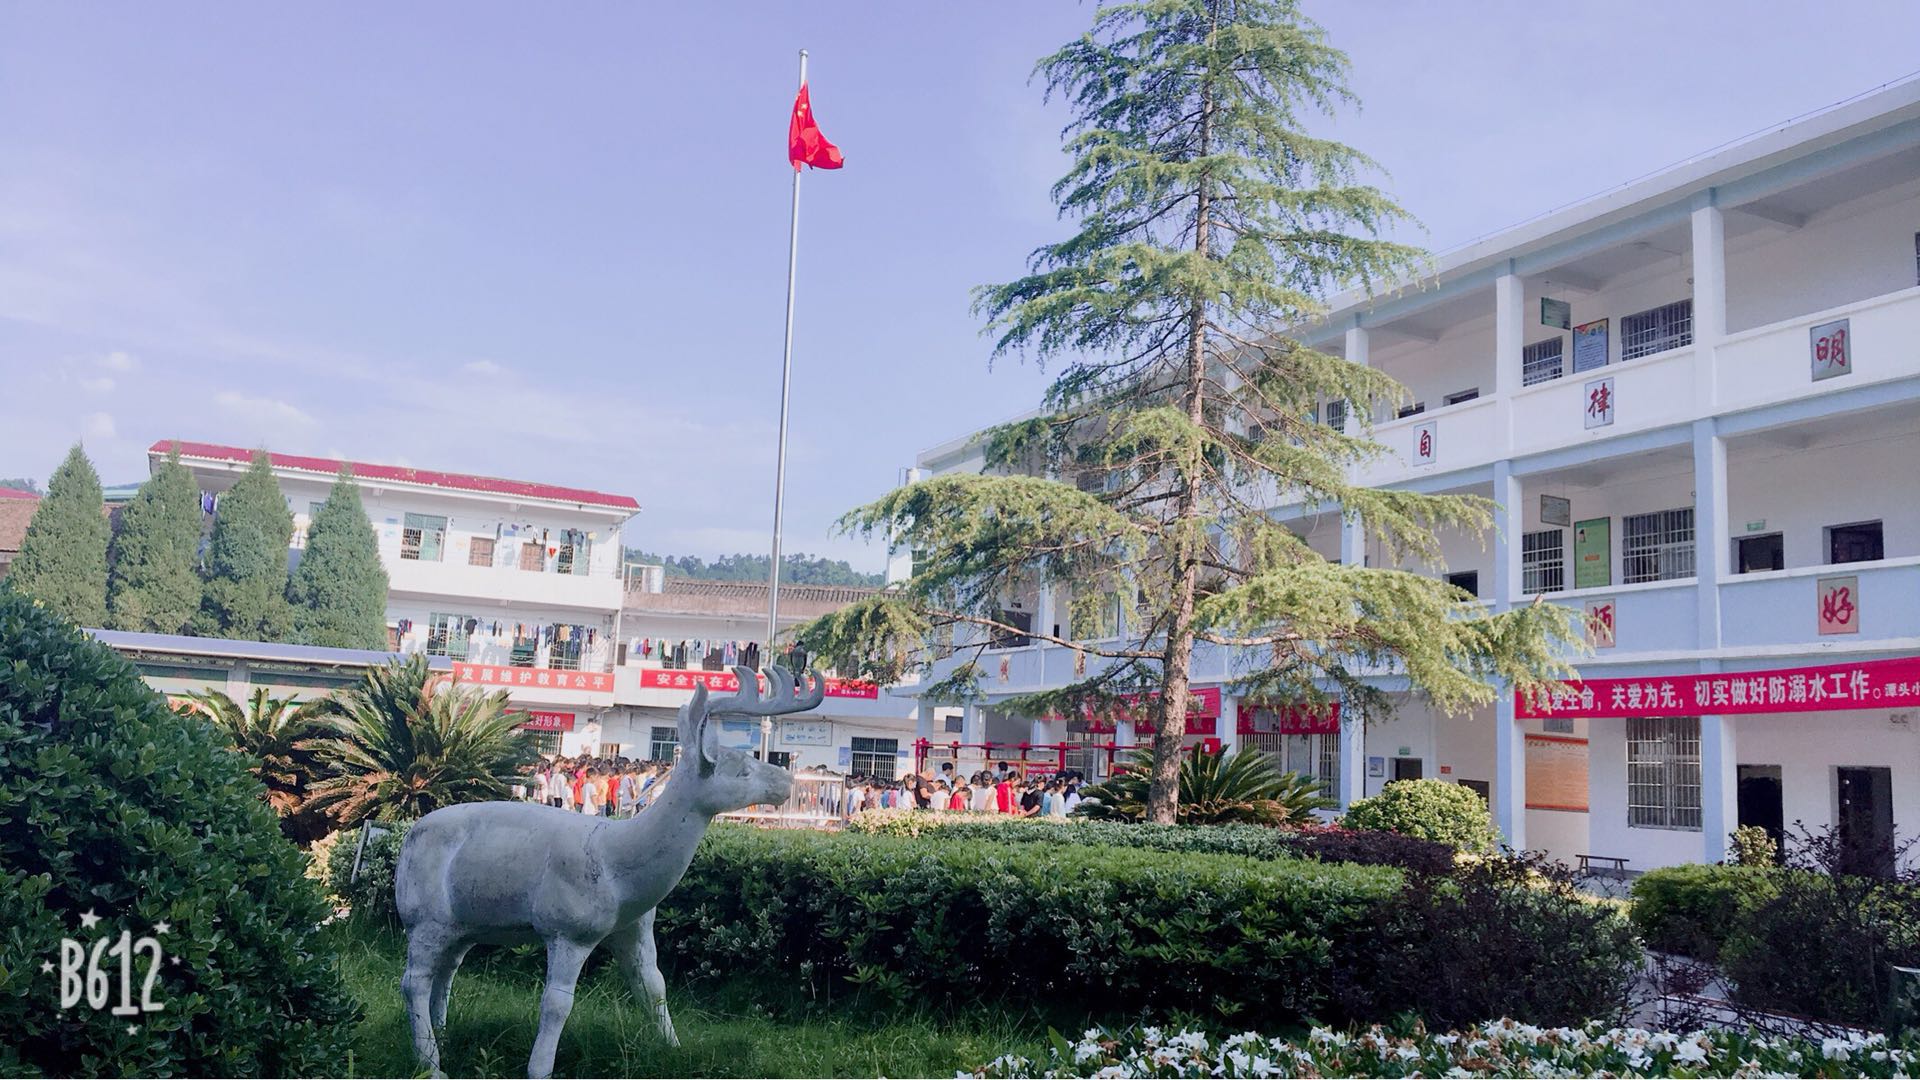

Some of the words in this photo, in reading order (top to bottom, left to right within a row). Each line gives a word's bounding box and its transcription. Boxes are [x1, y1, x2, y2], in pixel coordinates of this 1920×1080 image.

[1816, 329, 1846, 368] 明
[1588, 382, 1611, 422] 律
[1419, 429, 1431, 458] 自
[1823, 586, 1855, 625] 好
[462, 667, 605, 688] 发展维护教育公平
